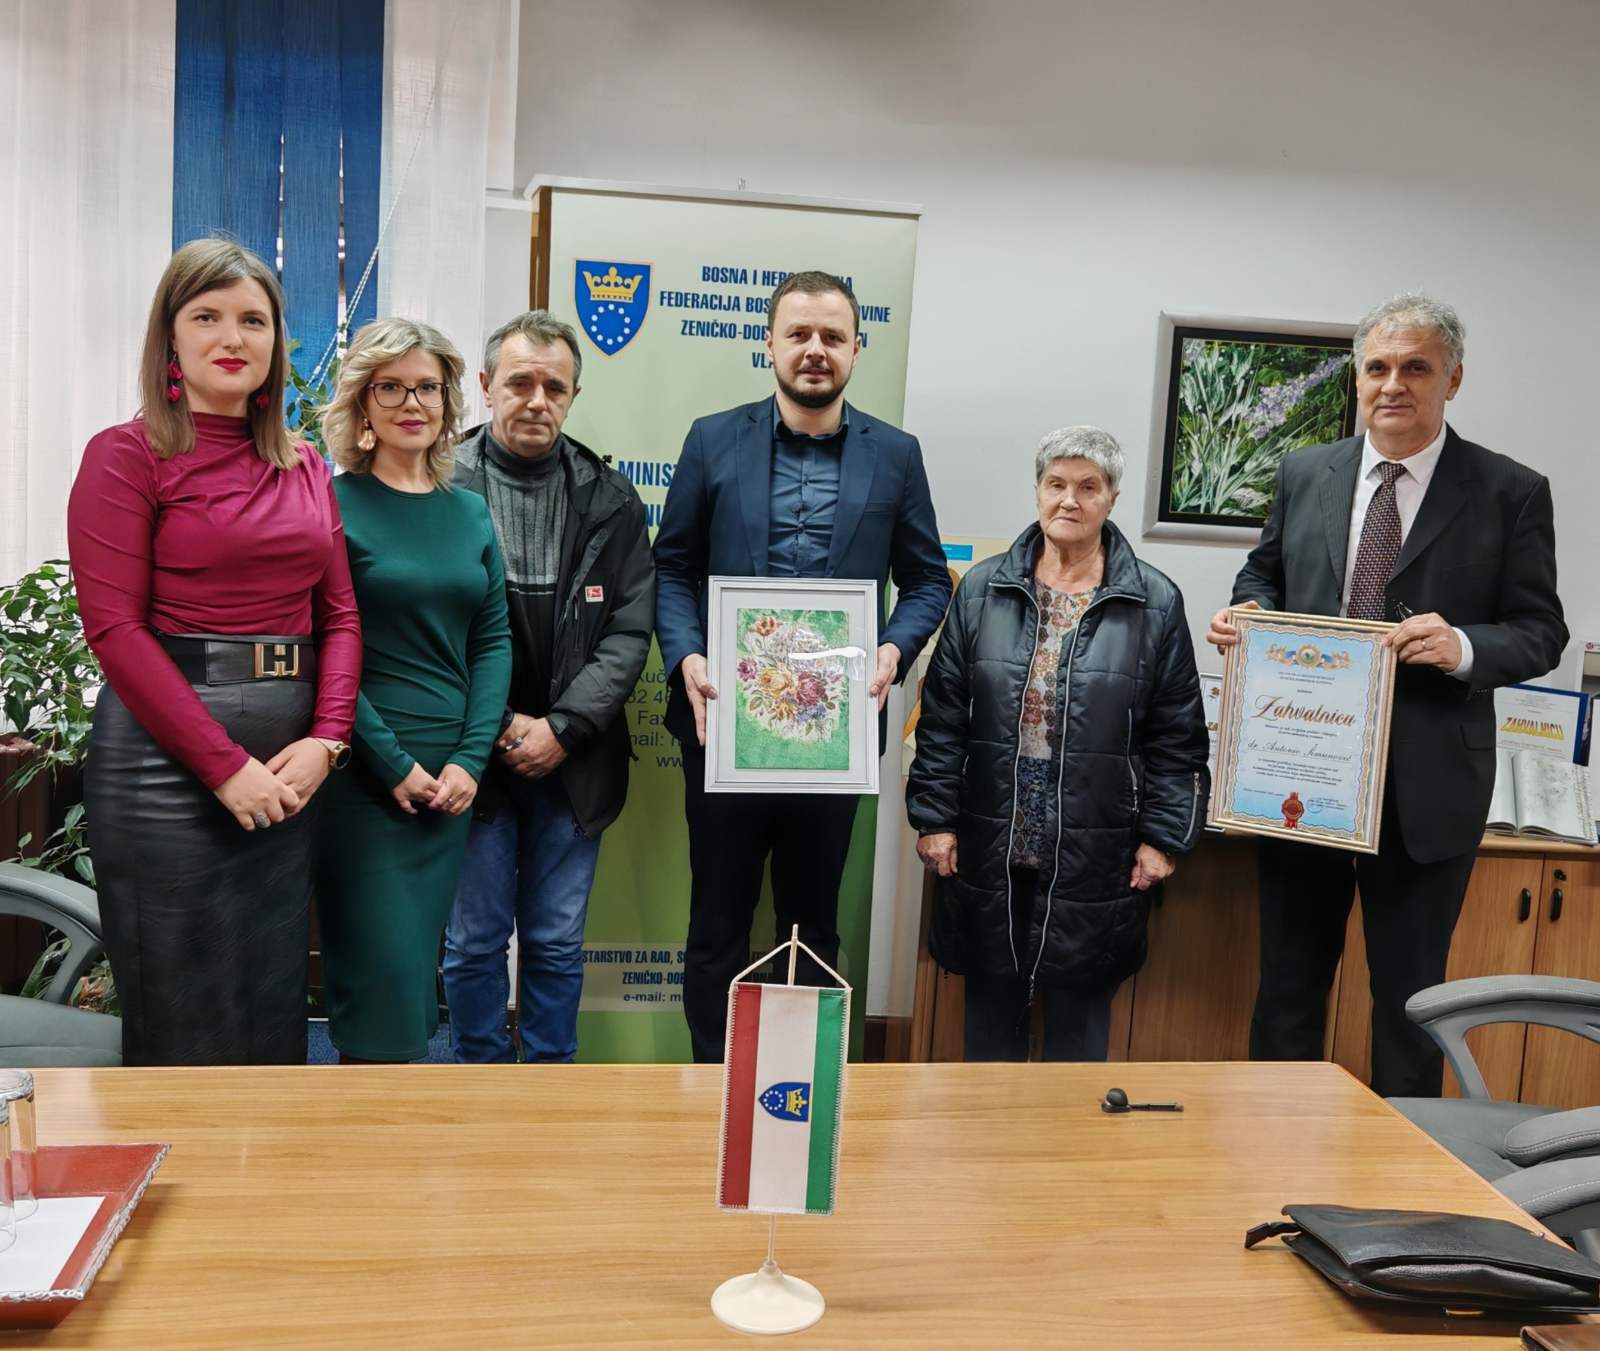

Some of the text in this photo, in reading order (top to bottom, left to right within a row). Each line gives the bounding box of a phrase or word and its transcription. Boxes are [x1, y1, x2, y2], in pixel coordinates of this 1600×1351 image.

[702, 266, 748, 285] BOSNA
[753, 269, 758, 285] I
[659, 290, 741, 312] FEDERACIJA
[859, 305, 891, 322] VINE
[618, 461, 678, 487] MINIS
[635, 951, 647, 964] ZA
[650, 951, 673, 966] RAD,
[623, 991, 666, 1003] e-mail:
